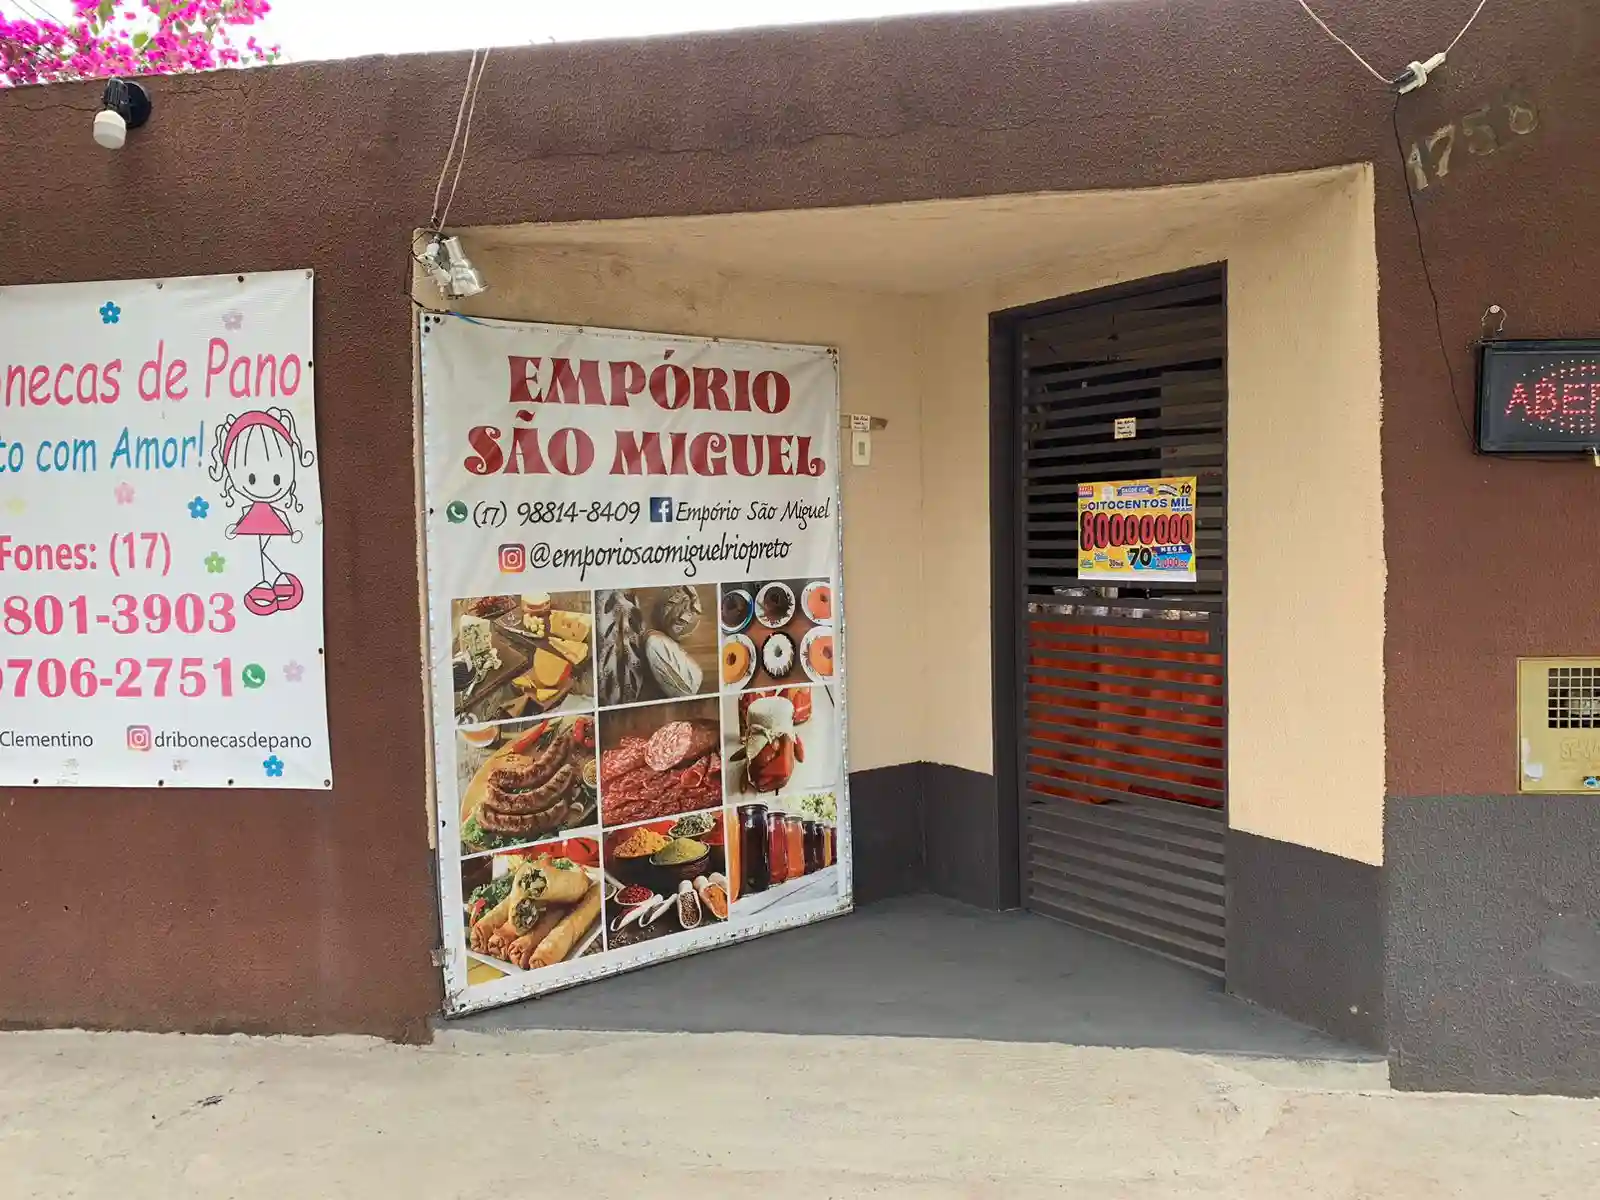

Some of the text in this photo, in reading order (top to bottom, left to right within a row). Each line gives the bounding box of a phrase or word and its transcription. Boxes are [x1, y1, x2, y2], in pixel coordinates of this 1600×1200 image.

[0, 337, 301, 407] necas de Pano
[507, 349, 791, 414] EMPÓRIO
[36, 439, 96, 472] com
[110, 420, 204, 471] Amor!
[463, 409, 826, 477] SÃO MIGUEL
[473, 500, 640, 528] (17) 98814-8409
[676, 497, 831, 532] Empório São Miguel
[1088, 497, 1192, 510] OITOCENTOS MIL
[0, 532, 171, 577] Fones: (17)
[530, 531, 792, 581] @emporiosaomiguelriopreto
[0, 657, 233, 698] 706-2751
[0, 731, 93, 748] Clementino
[154, 731, 312, 752] dribonecasdepano
